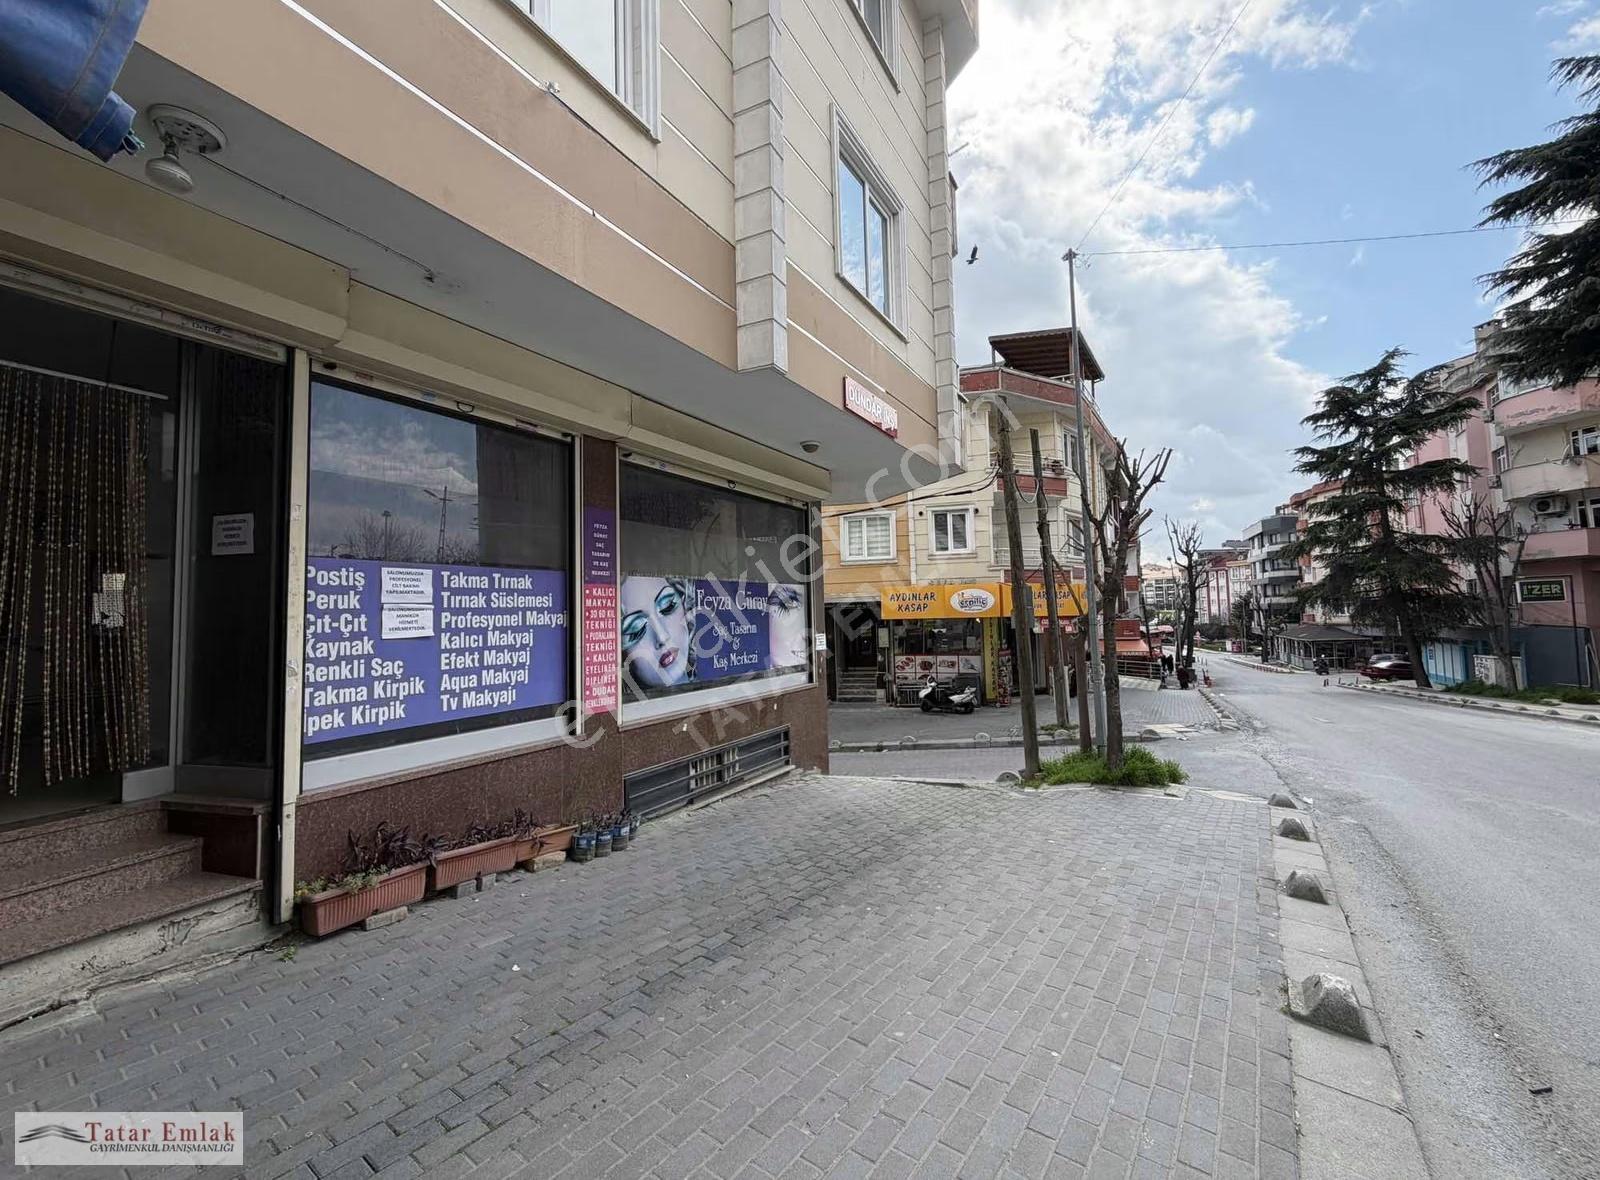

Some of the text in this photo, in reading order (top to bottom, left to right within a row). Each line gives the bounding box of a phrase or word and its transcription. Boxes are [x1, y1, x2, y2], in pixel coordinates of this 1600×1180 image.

[307, 565, 366, 591] Postiş
[441, 571, 533, 590] Takma Tırnak
[307, 590, 361, 609] Peruk
[441, 591, 553, 608] Tırnak Süslemesi
[585, 598, 616, 607] MAKYAJ
[592, 587, 616, 597] KALICI
[696, 589, 768, 617] Feyza Güray
[897, 603, 929, 613] KASAP
[441, 610, 567, 631] Profesyonel Makyaj
[305, 636, 375, 661] Kaynak
[441, 629, 534, 650] Kalıcı Makyaj
[441, 647, 531, 671] Efekt Makyaj
[592, 652, 616, 663] KALICI
[713, 649, 758, 672] Kaş Merkezi
[305, 657, 404, 683] Renkli Saç
[440, 665, 529, 693] Aqua Makyaj
[305, 676, 425, 707] Takma Kirpik
[440, 686, 517, 712] Tv Makyajı
[592, 685, 616, 697] DUDAK
[351, 700, 407, 726] Kirpik
